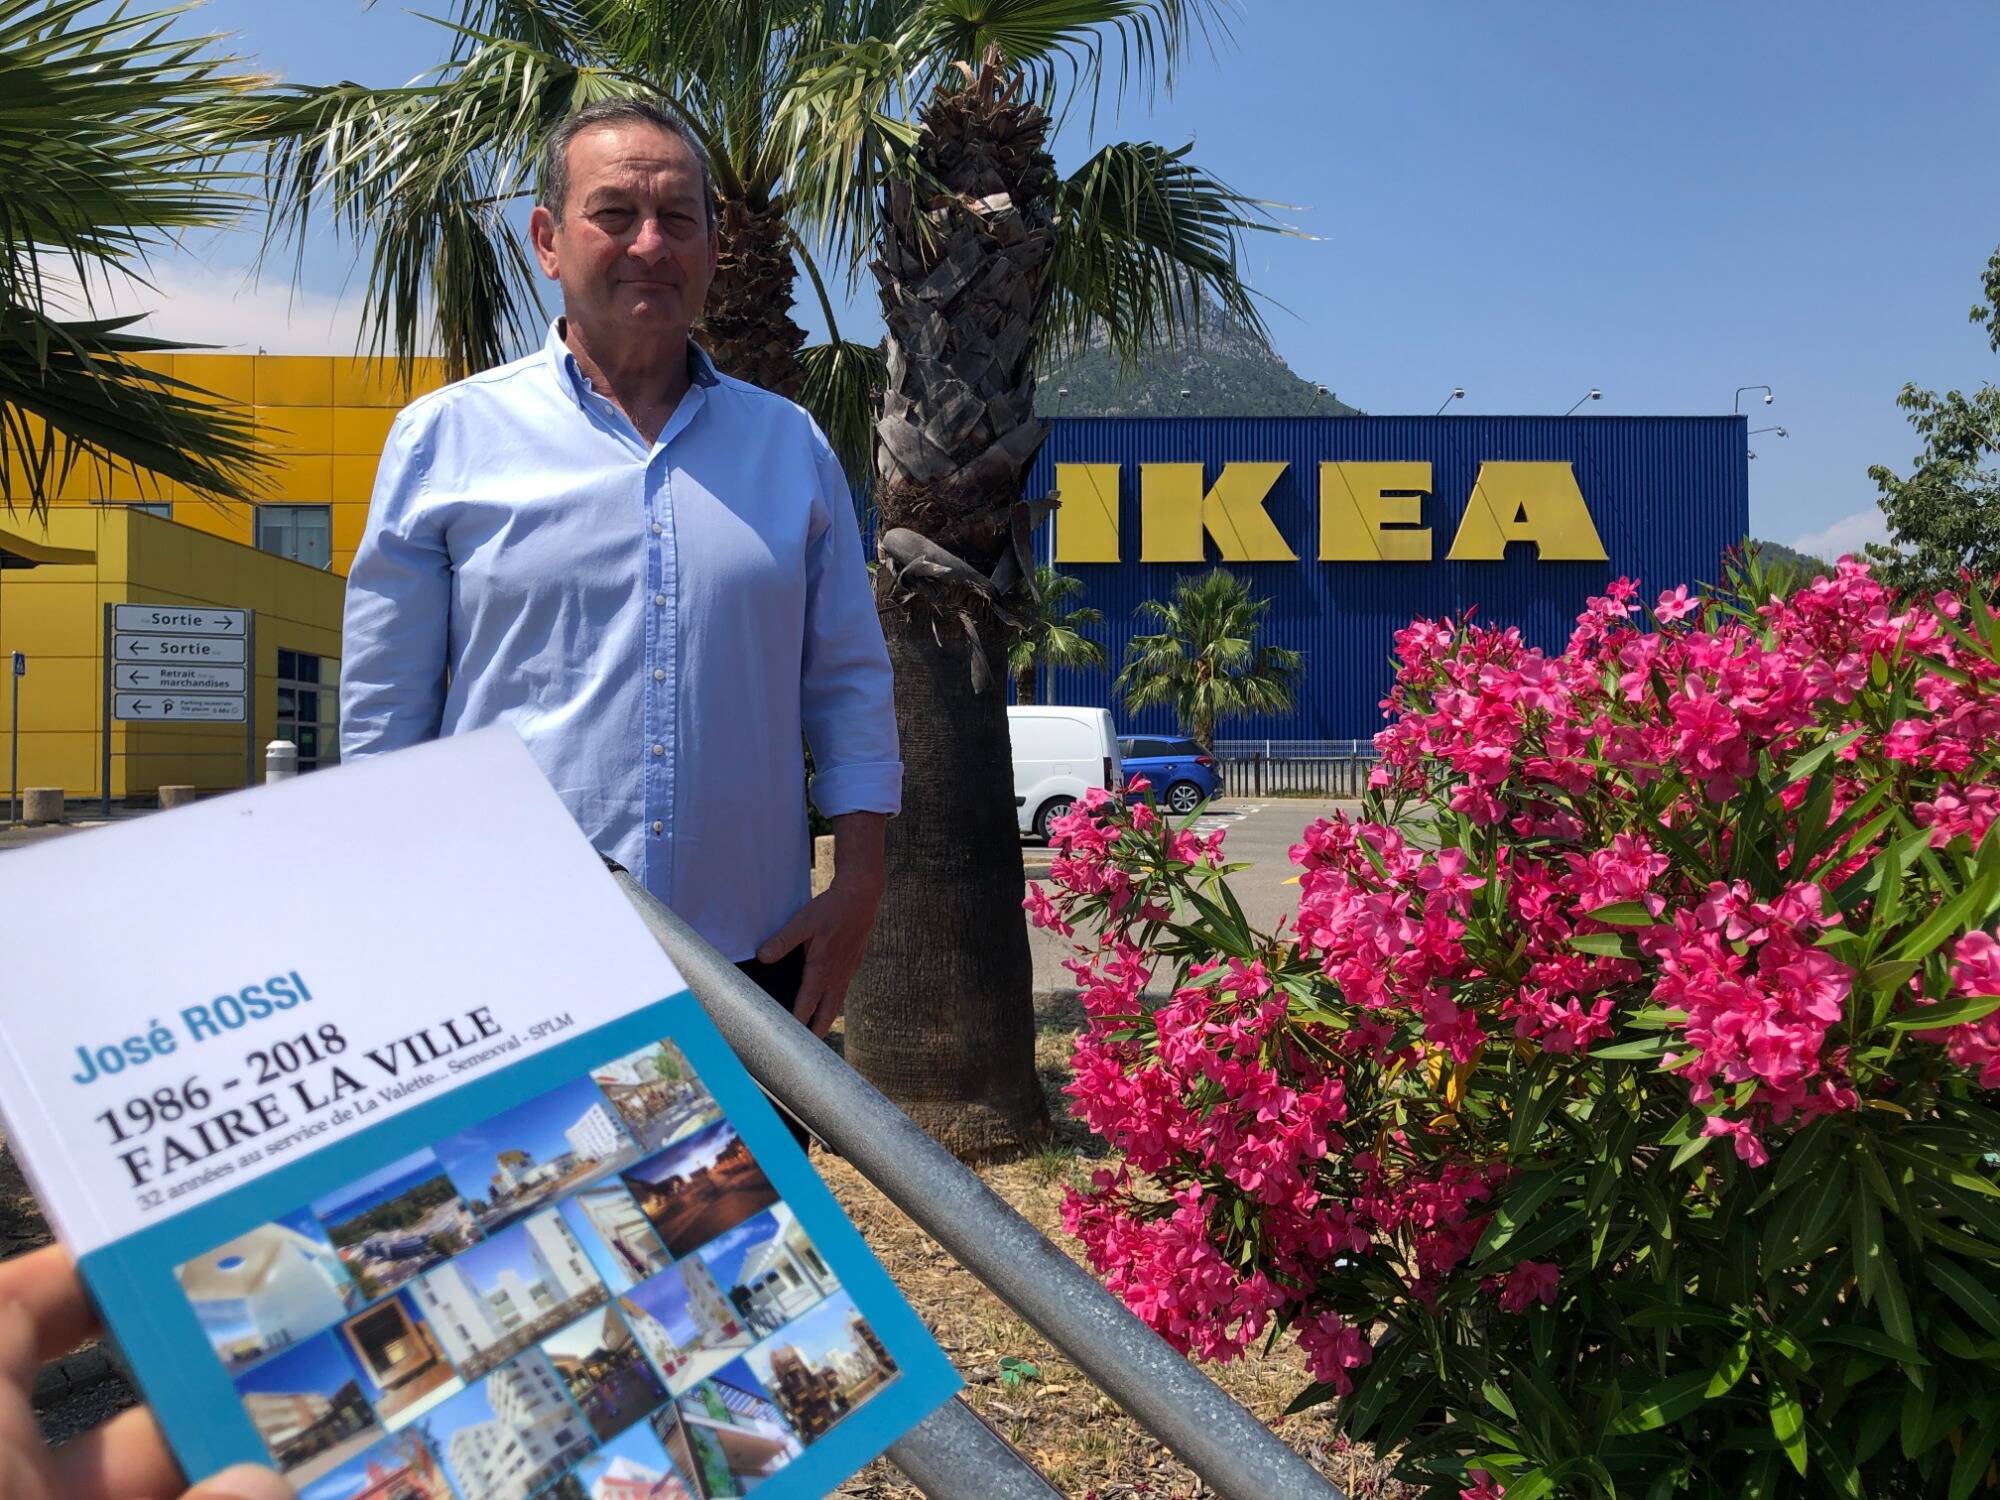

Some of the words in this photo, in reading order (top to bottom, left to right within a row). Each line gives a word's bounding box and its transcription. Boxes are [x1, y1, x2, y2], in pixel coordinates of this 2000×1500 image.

[1055, 461, 1609, 563] IKEA
[152, 613, 203, 626] Sortie
[160, 642, 211, 655] Sortie
[160, 669, 195, 679] Retrait
[160, 678, 230, 688] marchandises
[164, 703, 174, 715] P
[72, 1018, 178, 1084] José
[180, 970, 314, 1042] ROSSI
[95, 1075, 211, 1145] 1986
[246, 1023, 347, 1085] 2018
[117, 1093, 290, 1188] FAIRE
[290, 1065, 367, 1114] LA
[363, 1006, 503, 1077] VILLE
[138, 1190, 163, 1211] 32
[168, 1161, 236, 1199] années
[237, 1151, 262, 1169] au
[265, 1120, 329, 1156] service
[330, 1107, 354, 1126] de
[353, 1098, 379, 1116] La
[529, 1012, 575, 1040] SPLM
